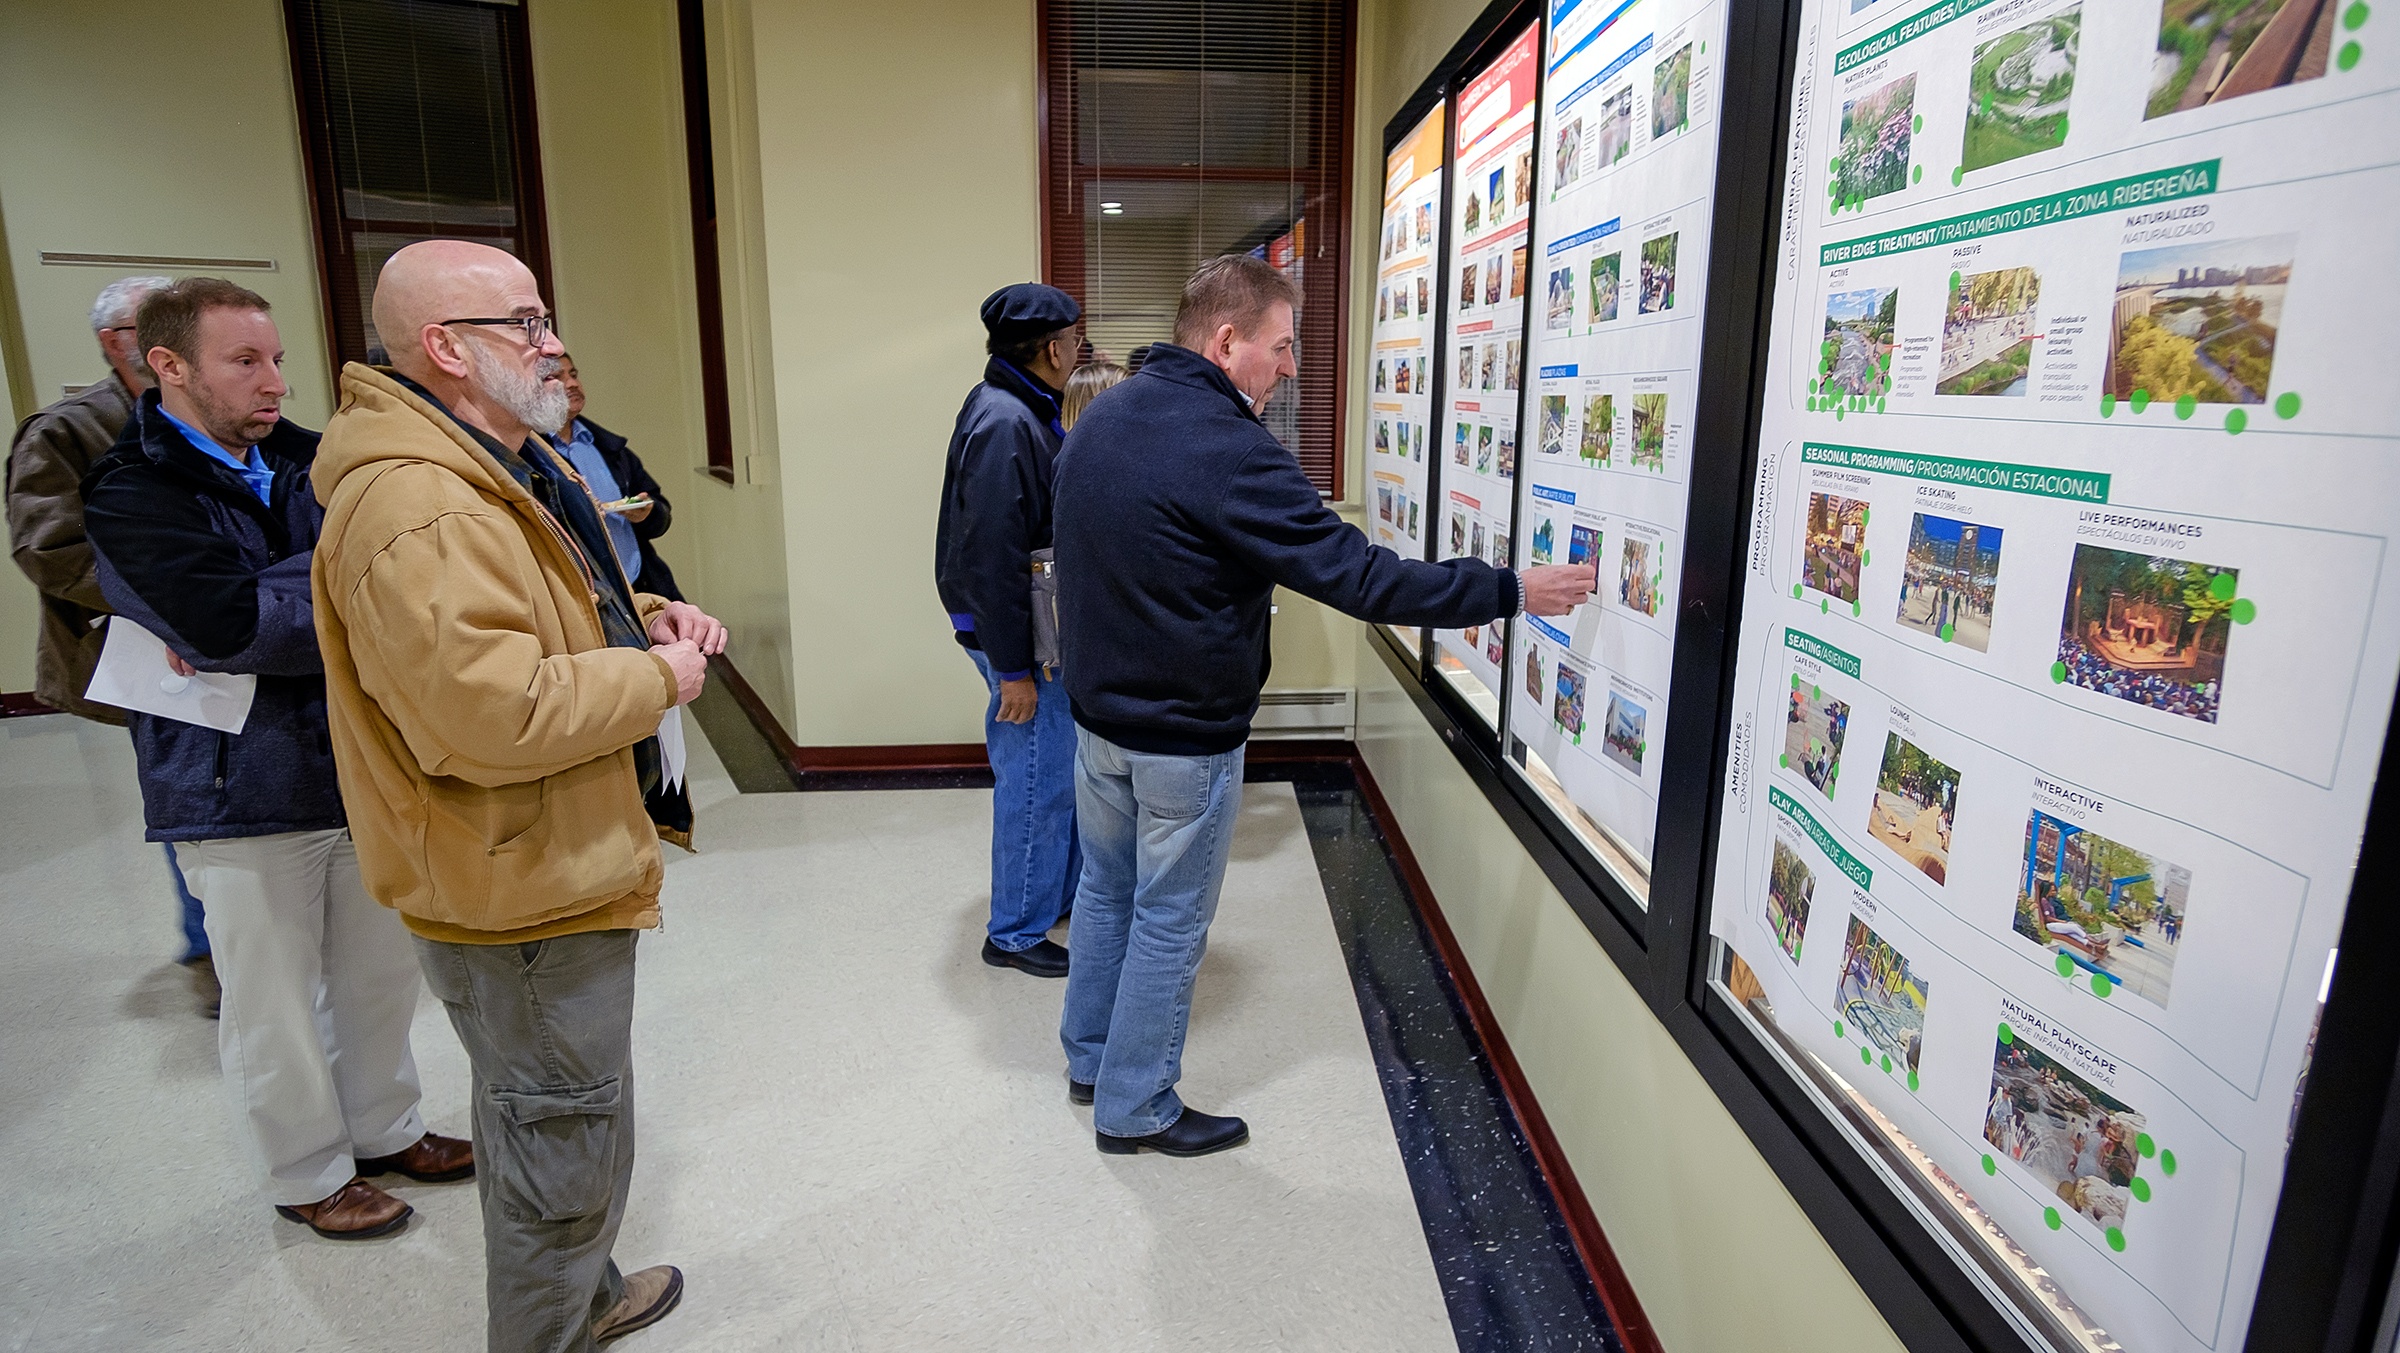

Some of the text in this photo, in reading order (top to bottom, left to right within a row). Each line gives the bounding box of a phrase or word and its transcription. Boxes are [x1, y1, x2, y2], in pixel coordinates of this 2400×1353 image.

[1837, 31, 1898, 72] ECOLOGICAL
[1801, 23, 1817, 126] GENERALES
[1844, 58, 1888, 85] NATIVE PLANTS
[1785, 75, 1806, 242] GENERAL FEATURES
[1823, 168, 2210, 264] RIVER EDGE TREATMENT/TRATAMIENTO DE LA ZONA RIBEREÑA
[2125, 204, 2210, 228] NATURALIZED
[2121, 221, 2216, 245] NATURALIZADO
[1953, 245, 1982, 258] PASSIVE
[1829, 267, 1849, 278] ACTIVE
[1805, 447, 2103, 500] SEASONAL PROGRAMMING/PROGRAMACIÓN ESTACIONAL
[1812, 469, 1871, 485] SUMMER FILM SCREENING
[1916, 485, 1956, 500] ICE SKATING
[1752, 457, 1769, 571] PROGRAMMING
[2079, 510, 2203, 538] LIVE PERFORMANCES
[2143, 535, 2158, 546] EN
[2160, 538, 2186, 550] VIVO
[1788, 633, 1859, 676] SEATING/ASIENTOS
[1808, 660, 1822, 673] STYLE
[1890, 704, 1910, 723] LOUNGE
[1731, 722, 1743, 797] AMENITIES
[1739, 711, 1752, 814] COMODIDADES
[2031, 791, 2086, 820] INTERACTIVO
[2034, 776, 2104, 813] INTERACTIVE
[1772, 792, 1791, 812] PLAY
[1829, 845, 1841, 862] DE
[1839, 856, 1868, 886] JUEGO
[1853, 888, 1878, 913] MODERN
[2000, 1010, 2116, 1089] PARQUE INFANTIL NATURAL
[2001, 997, 2118, 1075] NATURAL PLAYSCAPE
